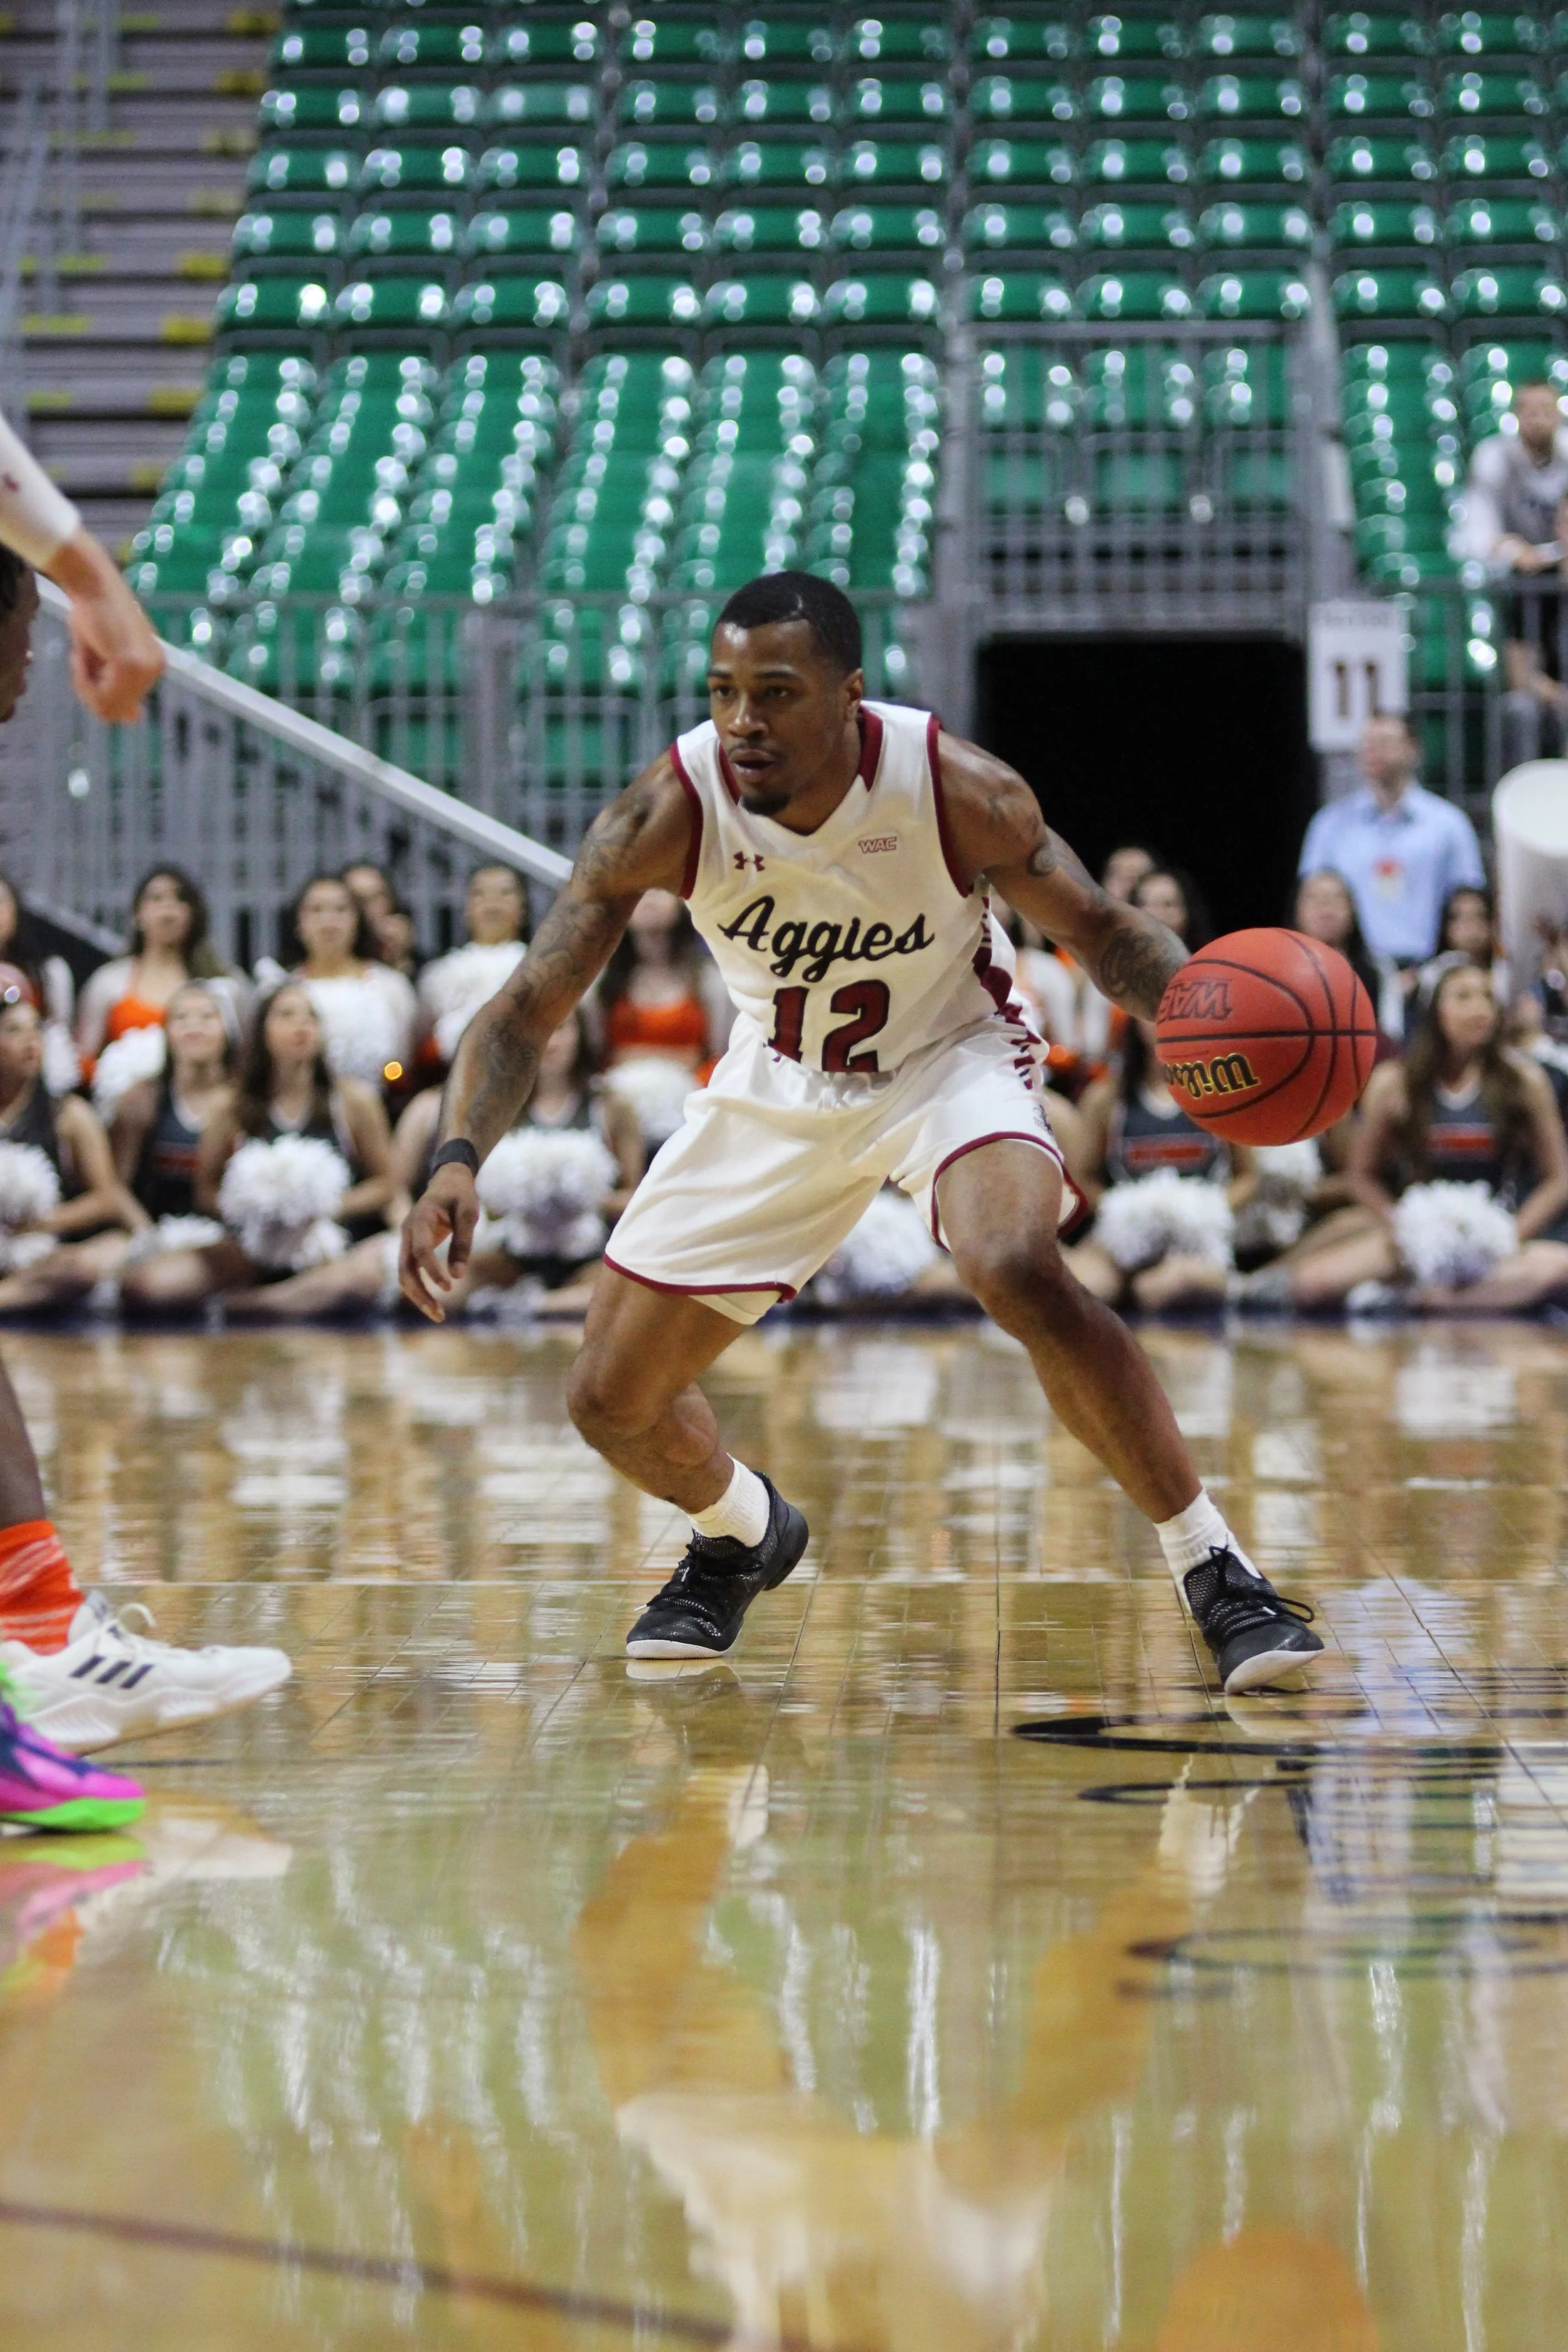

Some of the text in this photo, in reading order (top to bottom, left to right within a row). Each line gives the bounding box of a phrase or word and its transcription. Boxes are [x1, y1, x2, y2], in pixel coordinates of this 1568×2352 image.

[858, 836, 898, 854] WAC
[717, 894, 935, 983] Aggies
[768, 978, 891, 1073] 12
